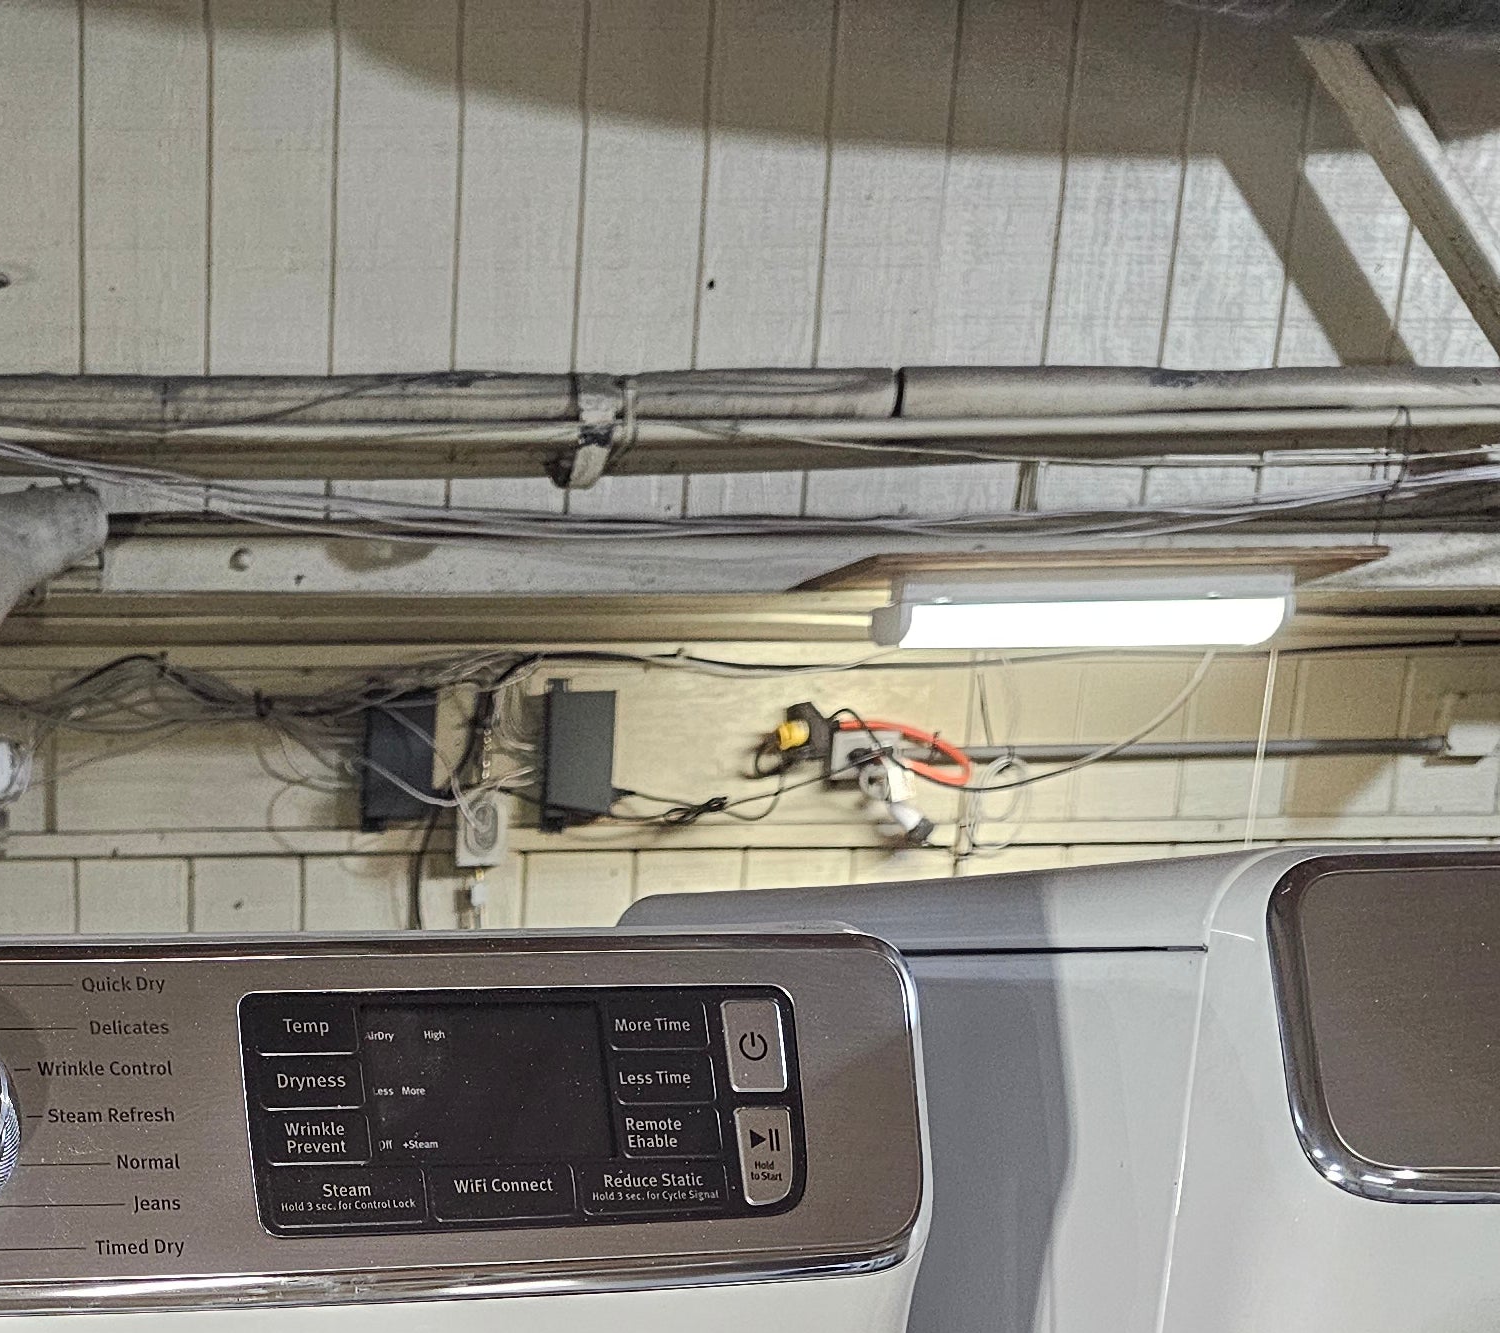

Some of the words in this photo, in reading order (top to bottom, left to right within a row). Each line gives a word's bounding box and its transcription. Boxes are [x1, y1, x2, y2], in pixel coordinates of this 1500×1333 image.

[81, 976, 132, 994] Quick
[136, 976, 166, 995] Dry
[89, 1019, 169, 1036] Delicates
[283, 1018, 329, 1036] Temp
[615, 1018, 651, 1032] More
[654, 1017, 691, 1032] Time
[423, 1030, 446, 1042] High
[37, 1060, 104, 1077] Wrinkle
[109, 1060, 173, 1076] Control
[277, 1073, 346, 1093] Dryness
[619, 1071, 653, 1085] Less
[656, 1070, 691, 1085] Time
[401, 1086, 426, 1096] More
[48, 1108, 102, 1125] Steam
[108, 1107, 175, 1124] Refresh
[284, 1122, 345, 1137] Wrinkle
[625, 1117, 682, 1131] Remote
[286, 1139, 347, 1154] Prevent
[403, 1139, 439, 1150] +Steam
[627, 1134, 678, 1148] Enable
[116, 1154, 180, 1170] Normal
[754, 1161, 775, 1171] Hold
[603, 1173, 658, 1188] Reduce
[661, 1172, 704, 1187] Static
[751, 1172, 760, 1181] to
[761, 1171, 782, 1182] Start
[322, 1183, 371, 1198] Steam
[453, 1178, 488, 1194] WiFi
[491, 1178, 554, 1193] Connect
[592, 1191, 615, 1201] Hold
[617, 1191, 623, 1201] 3
[625, 1191, 645, 1201] sec.
[647, 1190, 660, 1200] for
[661, 1190, 687, 1202] Cycle
[688, 1189, 719, 1201] Signal
[132, 1195, 181, 1212] Jeans
[281, 1202, 304, 1212] Hold
[307, 1201, 314, 1211] 3
[316, 1202, 337, 1211] sec.
[338, 1200, 352, 1211] for
[354, 1200, 391, 1210] Control
[393, 1198, 417, 1209] Lock
[95, 1239, 149, 1256] Timed
[154, 1238, 185, 1258] Dry
